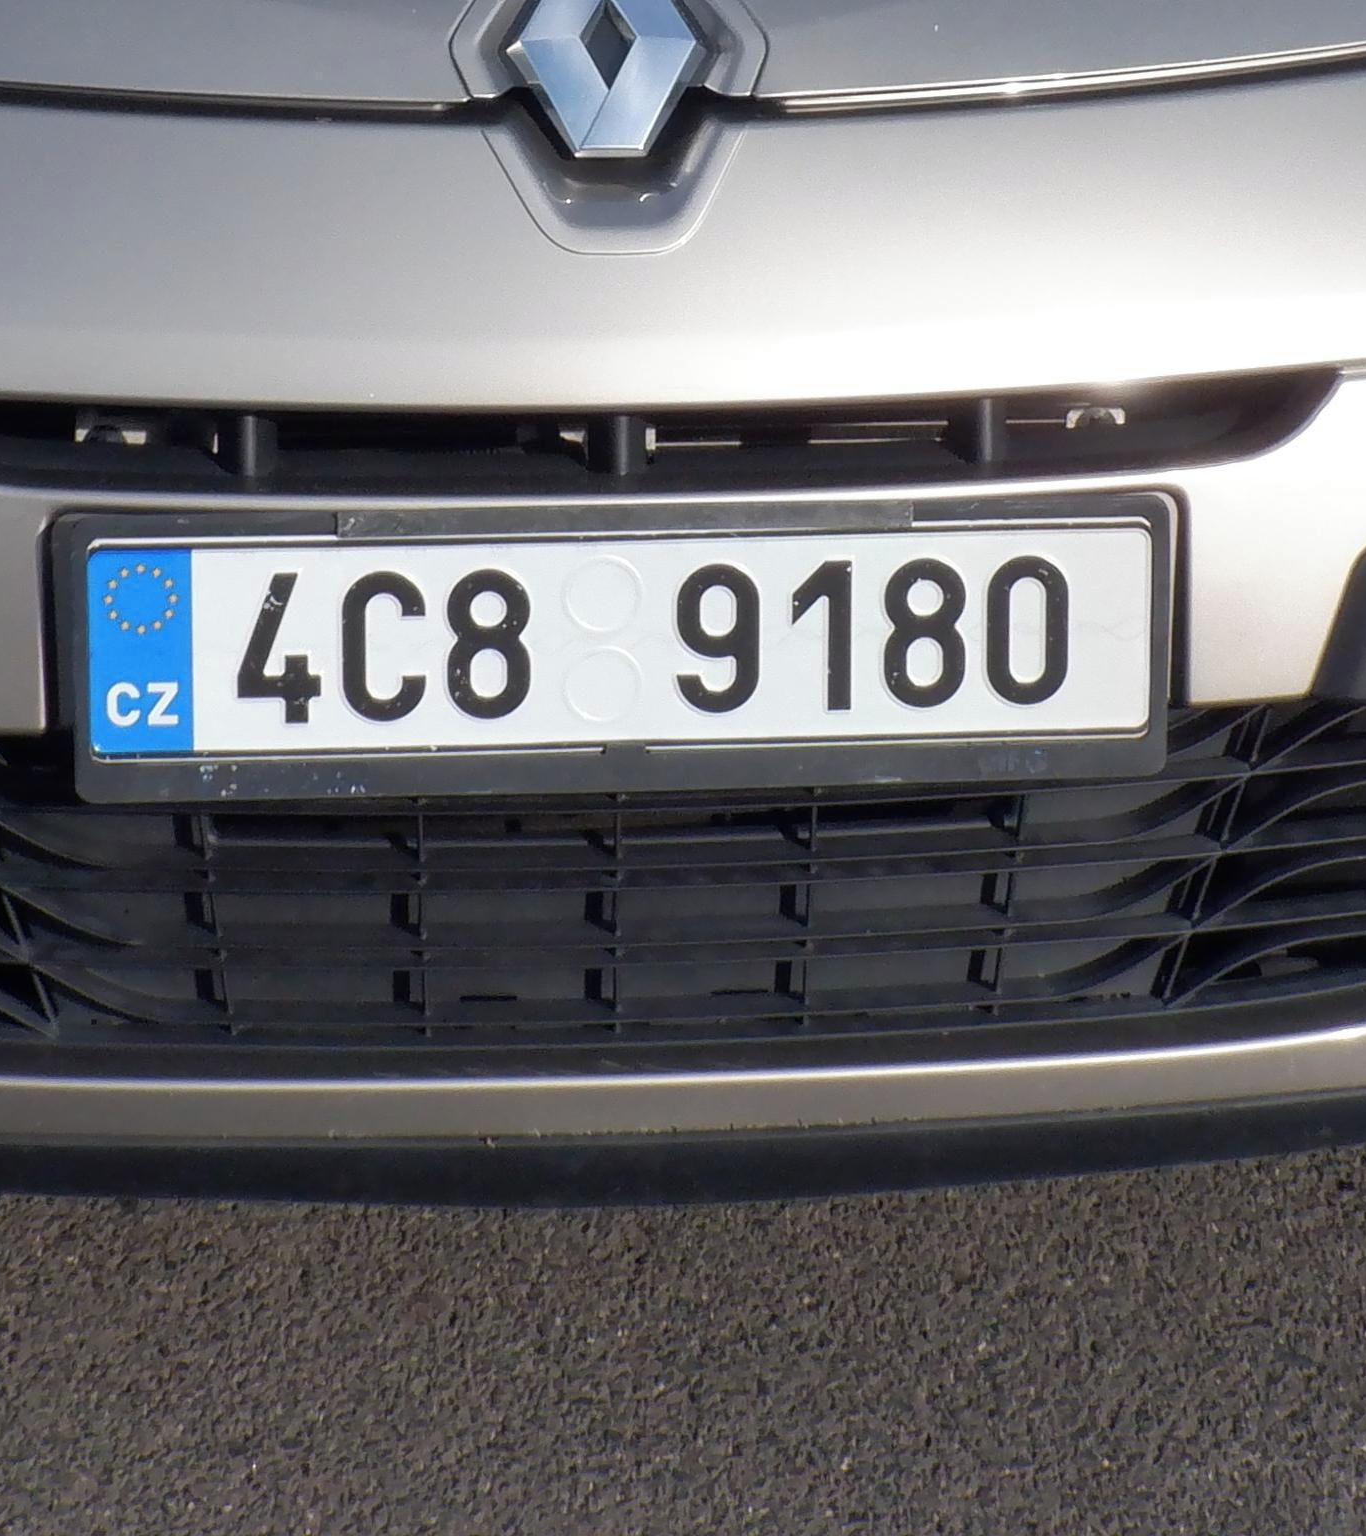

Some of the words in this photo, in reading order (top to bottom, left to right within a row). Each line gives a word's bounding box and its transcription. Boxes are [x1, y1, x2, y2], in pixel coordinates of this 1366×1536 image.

[235, 566, 533, 725] 4C8
[674, 553, 1070, 715] 9180
[106, 681, 179, 727] CZ
